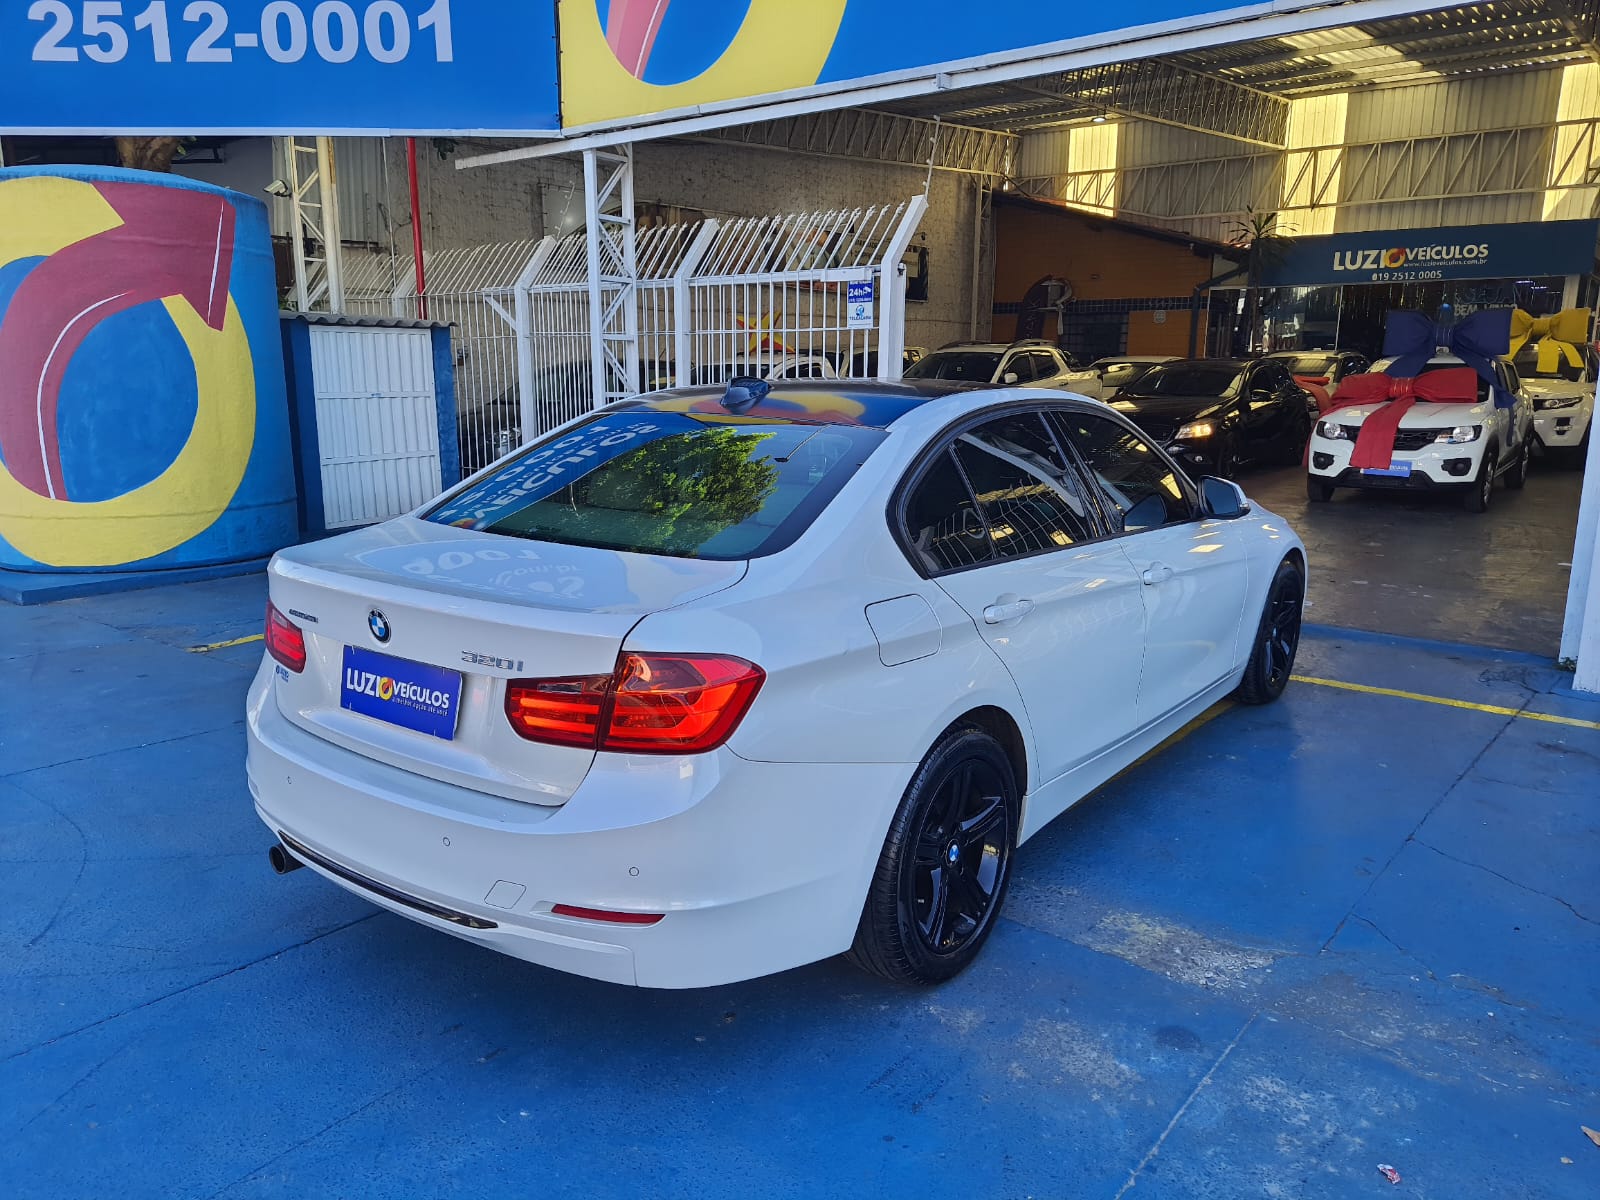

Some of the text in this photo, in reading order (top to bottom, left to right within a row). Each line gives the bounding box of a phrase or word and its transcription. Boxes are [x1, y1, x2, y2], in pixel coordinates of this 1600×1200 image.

[27, 0, 454, 63] 2512-0001
[1333, 243, 1489, 270] LUZIO VEÍCULOS
[1392, 271, 1415, 280] 2512
[1418, 270, 1442, 279] 0005
[346, 667, 450, 709] LUZIO VEÍCULOS
